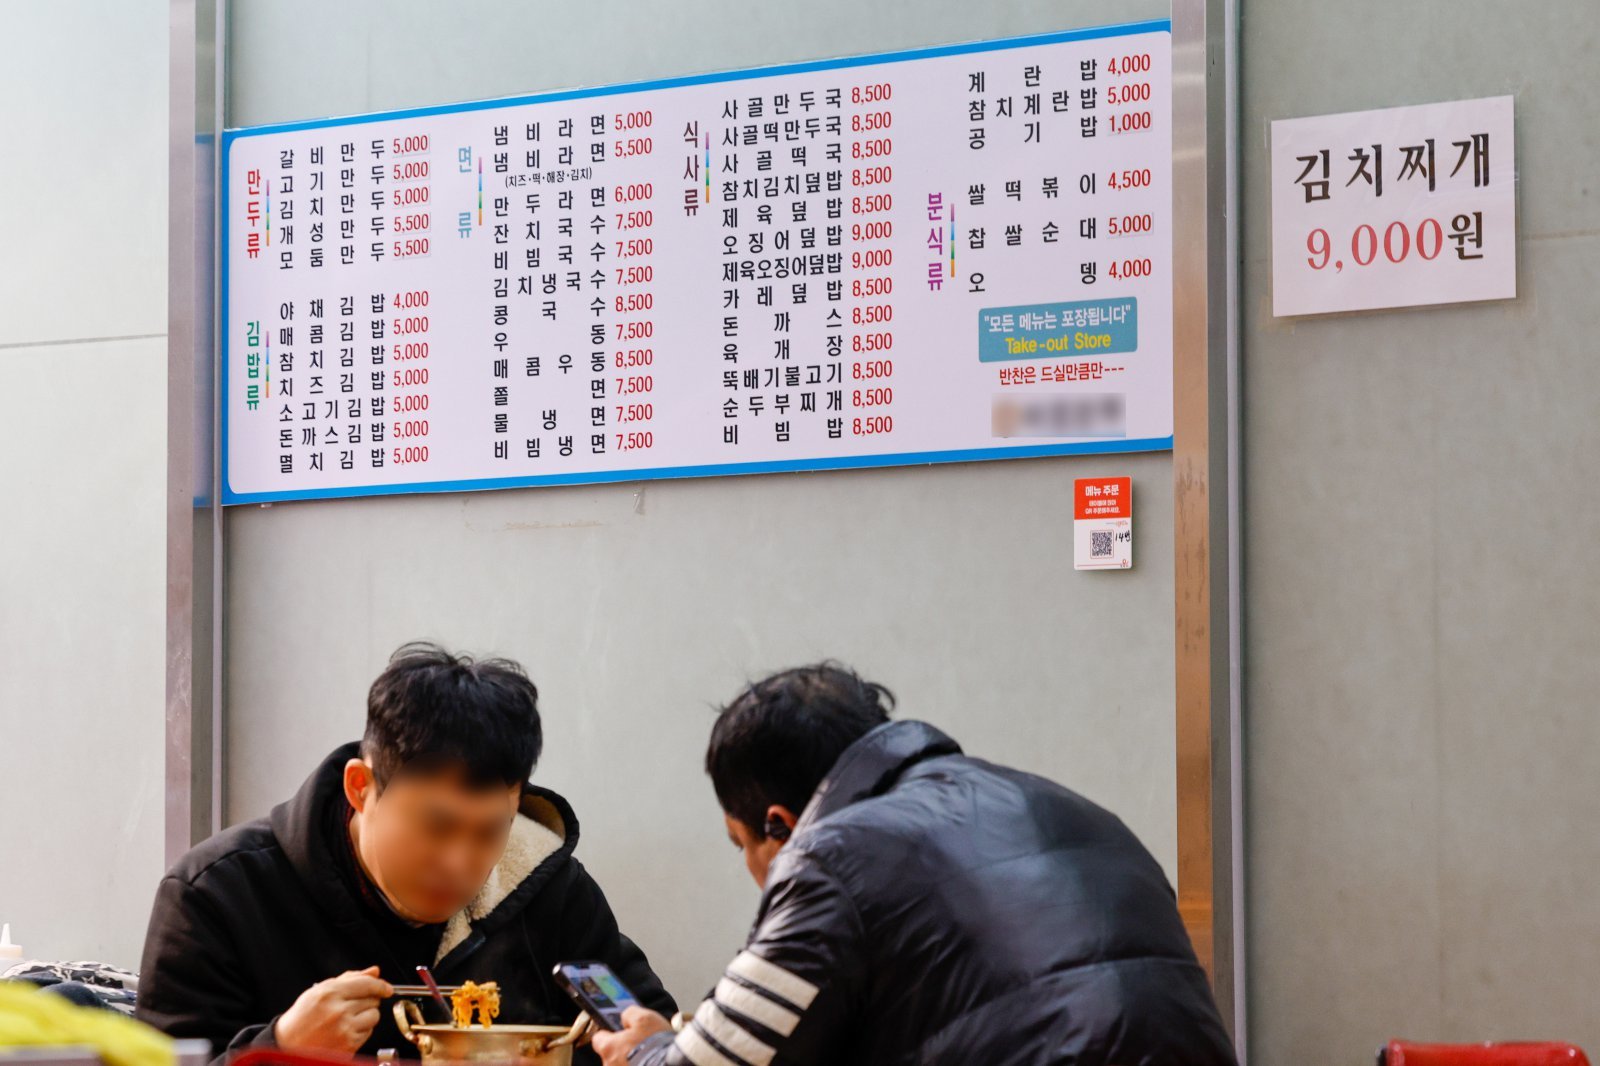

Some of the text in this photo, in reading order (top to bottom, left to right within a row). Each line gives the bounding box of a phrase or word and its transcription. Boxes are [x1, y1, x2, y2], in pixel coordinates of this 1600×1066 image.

[1107, 54, 1151, 76] 4,000
[852, 84, 892, 105] 8,500
[1107, 83, 1151, 105] 5,000
[615, 111, 652, 131] 5,000
[852, 112, 892, 133] 8,500
[1107, 111, 1151, 134] 1,000
[393, 135, 429, 155] 5,000
[615, 138, 652, 158] 5,500
[852, 139, 892, 160] 8,500
[393, 162, 429, 181] 5,000
[684, 120, 699, 216] 식사류
[852, 166, 892, 187] 8,500
[1294, 133, 1490, 203] 김치찌개
[1108, 169, 1152, 191] 4,500
[393, 187, 429, 206] 5,000
[458, 146, 472, 239] 면류
[615, 183, 652, 203] 6,000
[247, 169, 261, 259] 만두류
[852, 194, 892, 215] 8,500
[393, 214, 429, 233] 5,500
[615, 210, 652, 231] 7,500
[1108, 215, 1152, 236] 5,000
[852, 221, 892, 242] 9,000
[927, 192, 943, 291] 분식류
[393, 238, 429, 258] 5,500
[615, 238, 652, 259] 7,500
[1306, 211, 1484, 274] 9,000원
[852, 249, 893, 270] 9,000
[1108, 259, 1152, 280] 4,000
[615, 266, 653, 286] 7,500
[852, 277, 893, 298] 8,500
[393, 291, 429, 310] 4,000
[615, 293, 653, 313] 8,500
[852, 305, 893, 325] 8,500
[1019, 312, 1057, 331] 메뉴는
[393, 317, 429, 336] 5,000
[615, 321, 653, 341] 7,500
[852, 333, 893, 353] 8,500
[1075, 333, 1112, 349] Store
[393, 343, 429, 362] 5,000
[615, 349, 653, 369] 8,500
[247, 321, 260, 410] 김밥류
[852, 360, 893, 381] 8,500
[999, 366, 1036, 385] 반찬은
[393, 368, 429, 387] 5,000
[615, 376, 653, 395] 7,500
[393, 395, 429, 413] 5,000
[852, 388, 893, 408] 8,500
[615, 404, 653, 423] 7,500
[393, 420, 429, 439] 5,000
[852, 416, 893, 436] 8,500
[615, 432, 653, 451] 7,500
[393, 446, 429, 465] 5,000
[1085, 484, 1119, 496] 메뉴 주문
